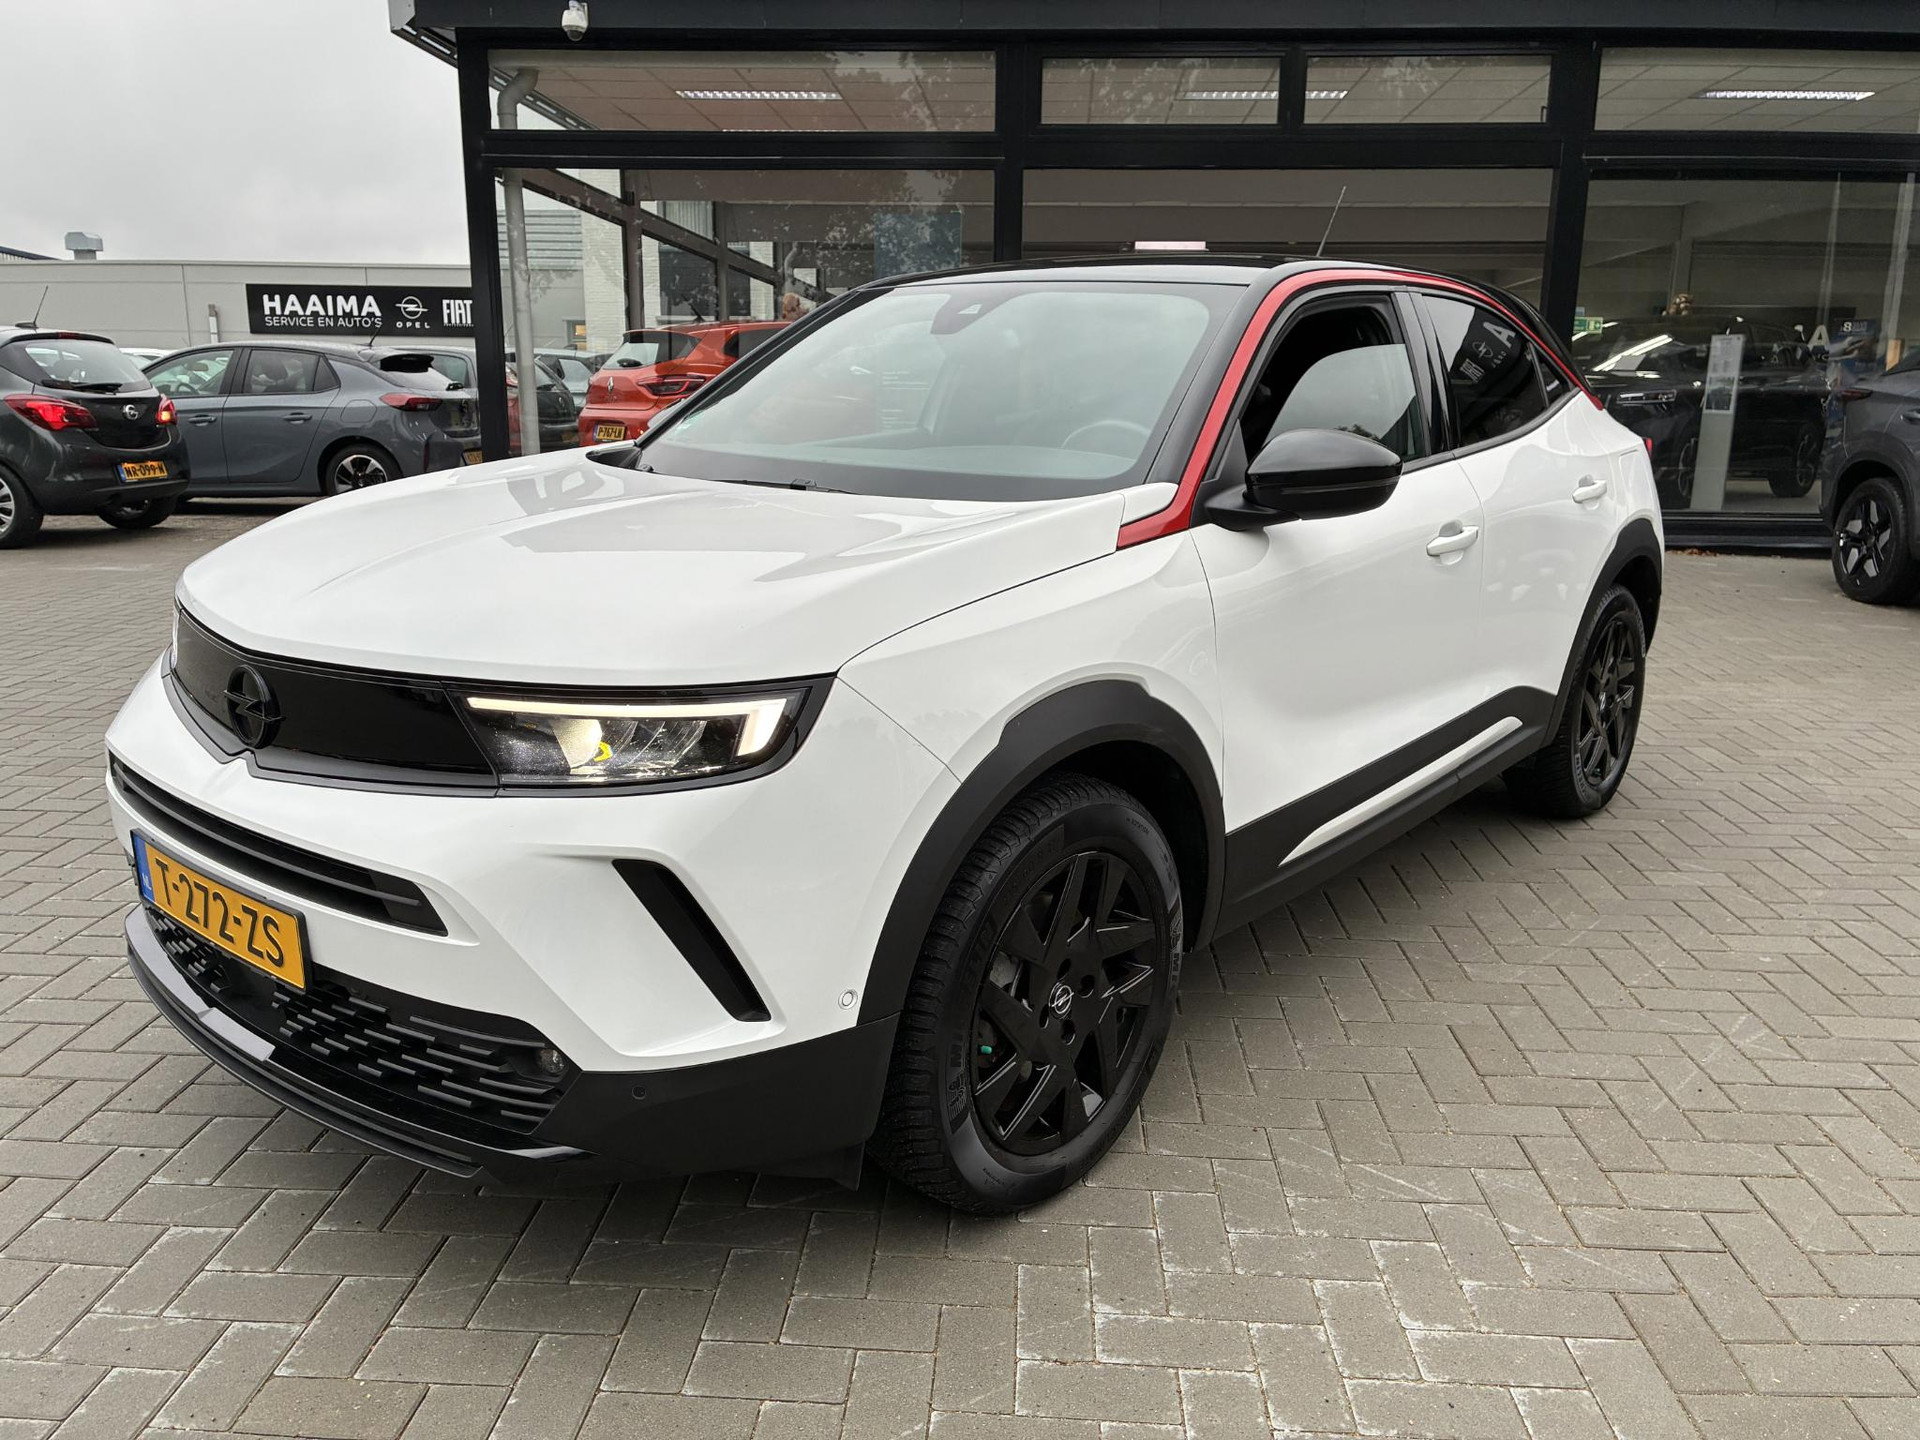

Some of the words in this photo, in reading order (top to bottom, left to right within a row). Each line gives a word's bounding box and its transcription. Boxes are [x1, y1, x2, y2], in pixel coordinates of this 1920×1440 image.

[262, 294, 382, 317] HAAIMA
[442, 299, 473, 324] FIAT
[265, 316, 315, 327] SERVICE
[318, 317, 334, 327] EN
[337, 317, 382, 328] AUTO'S
[396, 321, 431, 329] OPEL
[155, 857, 284, 968] T-272-ZS
